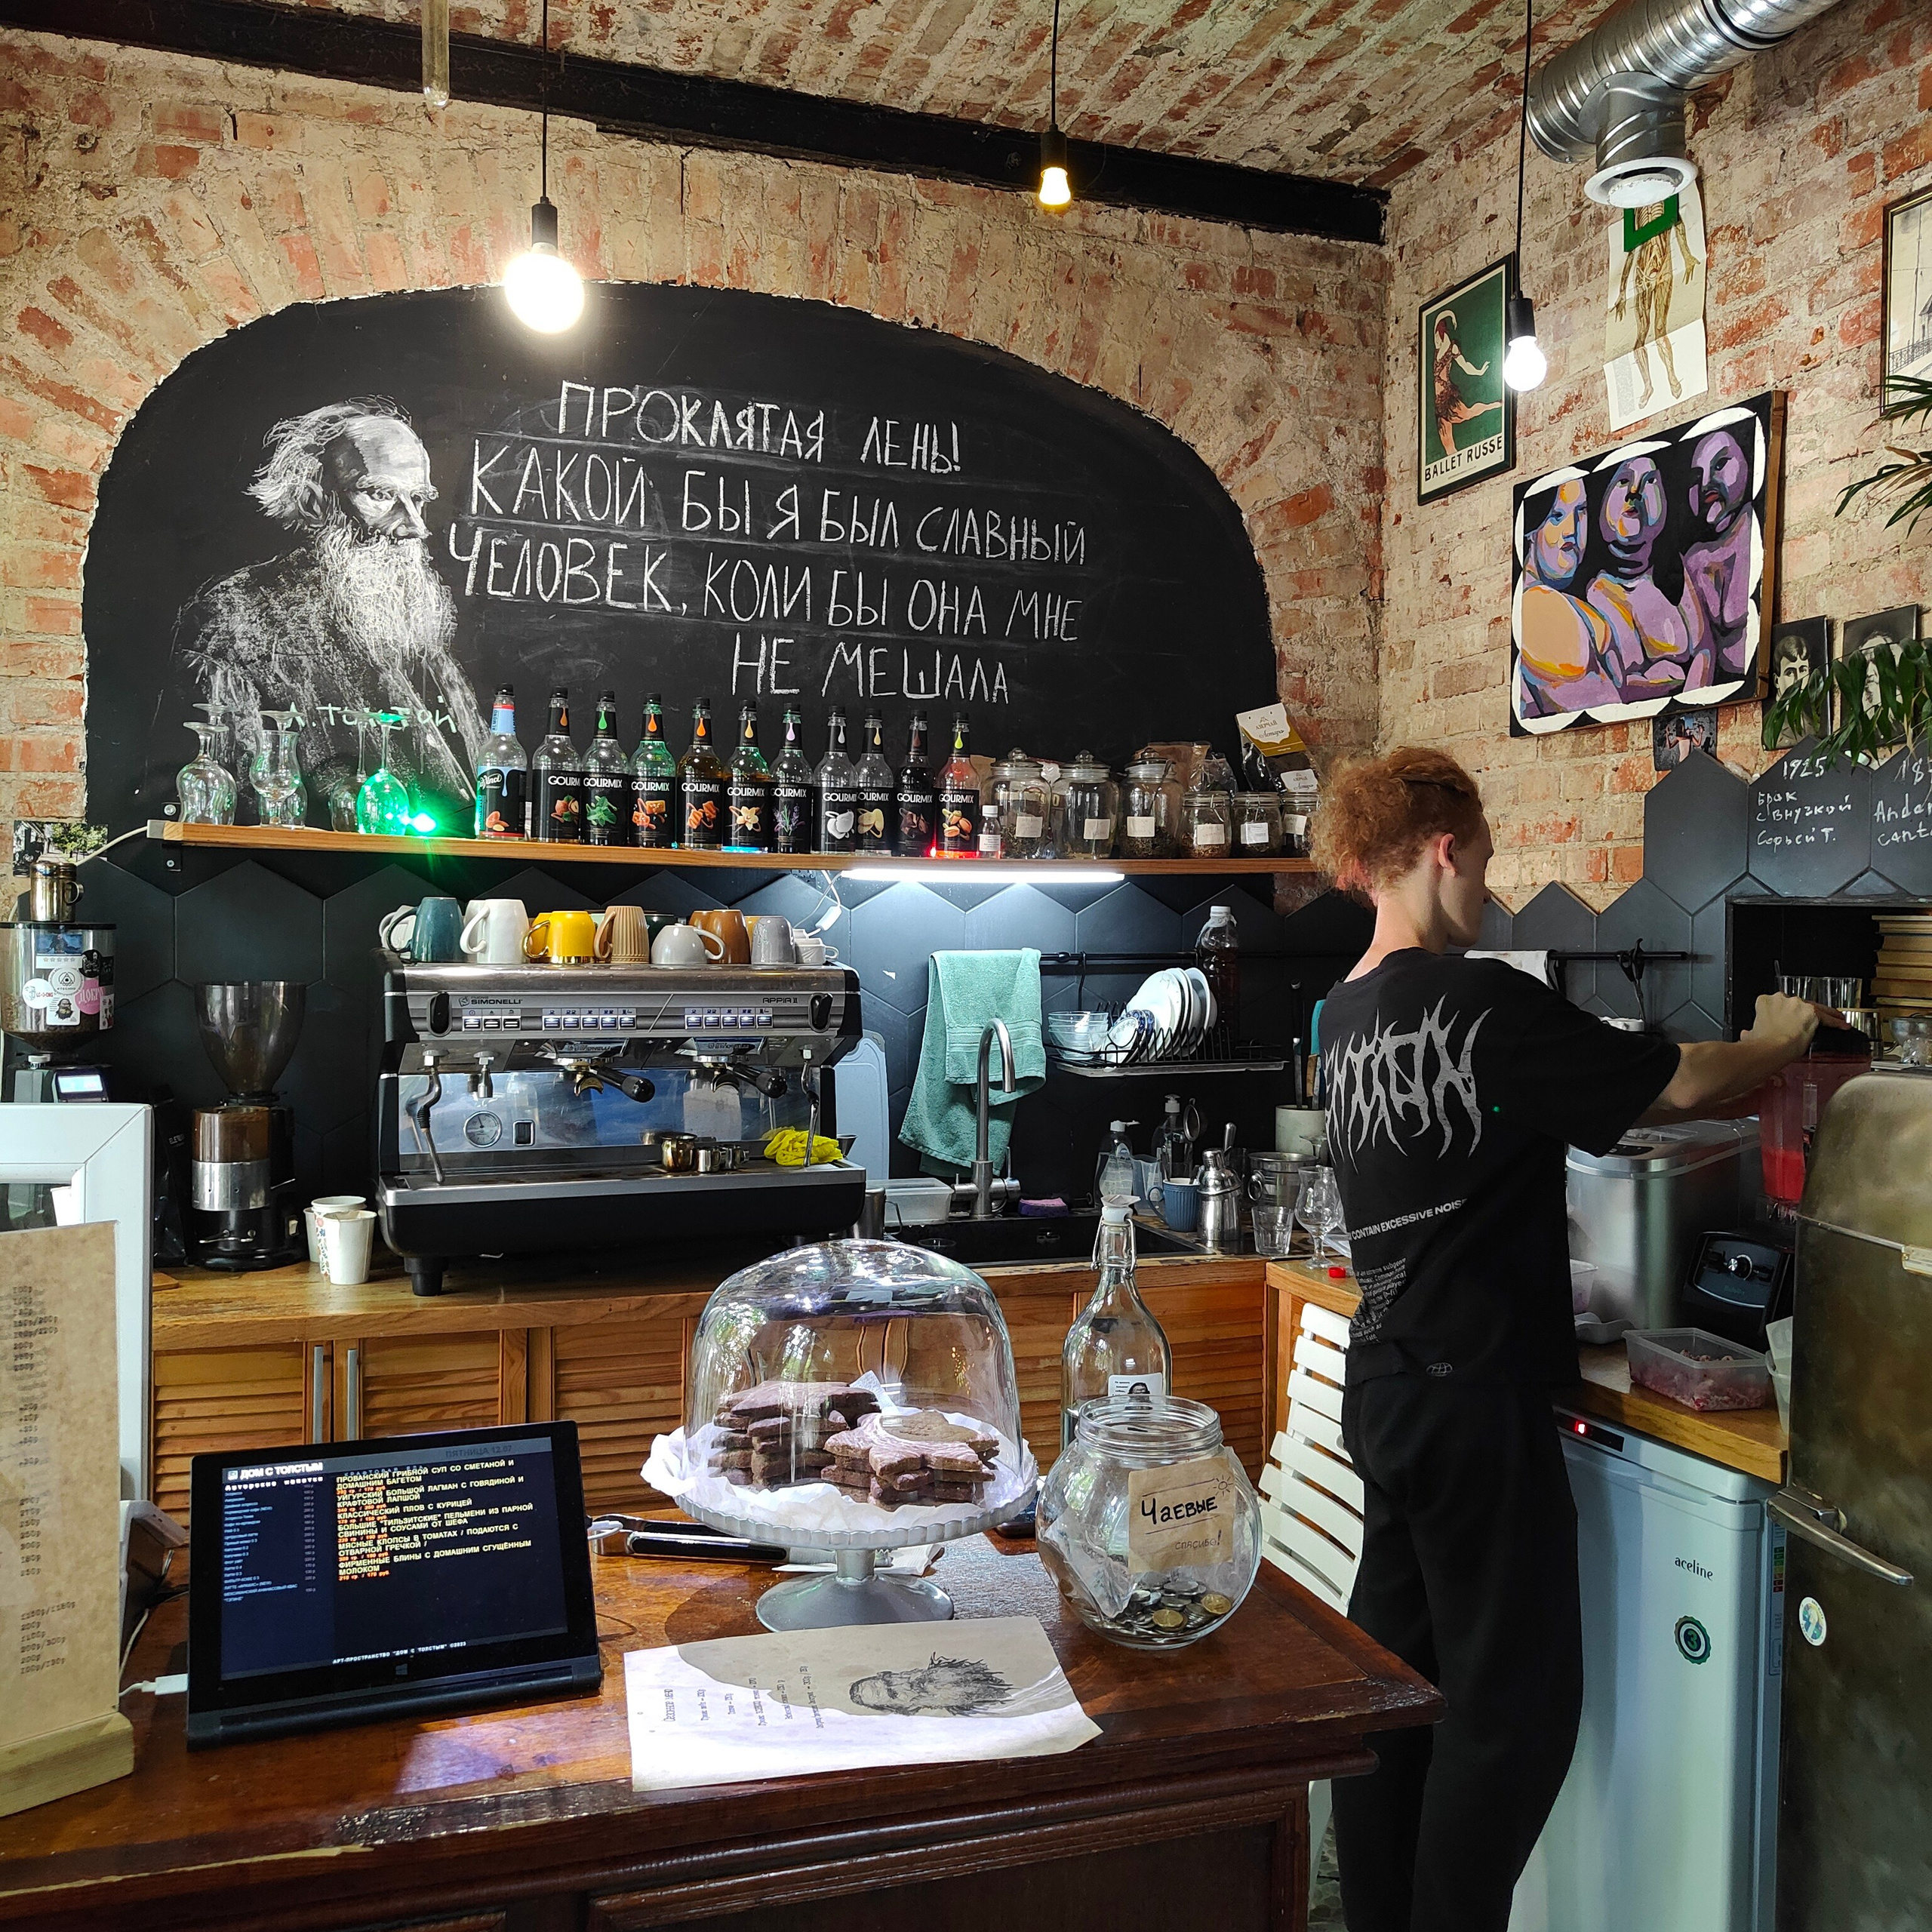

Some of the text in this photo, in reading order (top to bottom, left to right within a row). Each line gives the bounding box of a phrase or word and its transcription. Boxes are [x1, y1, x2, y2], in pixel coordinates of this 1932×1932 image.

[558, 380, 961, 475] ПРОКЛЯТАЯ ЛЕНЬ!
[1425, 453, 1463, 482] BALLET
[1466, 435, 1503, 463] RUSSE
[472, 438, 1085, 566] КАКОЙ БЫ Я БЫЛ СЛАВНЫЙ
[448, 523, 1082, 641] ЧЕЛОВЕК, КОЛИ БЫ ОНА МНЕ
[733, 632, 1008, 705] НЕ МЕШАЛА
[1782, 755, 1828, 780] 1925
[583, 777, 623, 789] GOURMIX
[631, 781, 670, 792] GOURMIX
[681, 782, 720, 792] GOURMIX
[727, 787, 765, 797] GOURMIX
[770, 788, 808, 798] GOURMIX
[897, 793, 933, 803] GOURMIX
[939, 794, 974, 804] GOURMIX
[1351, 1223, 1382, 1241] CONTAIN
[1380, 1208, 1434, 1232] EXCESSIVE
[445, 1447, 489, 1458] ПЯТНИЦА
[240, 1462, 324, 1480] ДОМ С ТОЛСТЫМ
[336, 1471, 389, 1483] ПРОВАНСКИЙ
[392, 1466, 429, 1478] ГРИБНОЙ
[432, 1465, 447, 1474] СУП
[450, 1463, 462, 1472] СО
[464, 1460, 506, 1471] СМЕТАНОЙ
[336, 1475, 422, 1491] ДОМАШНИМ БАГЕТОМ
[386, 1485, 425, 1497] БОЛЬШОЙ
[427, 1483, 458, 1493] ЛАГМАН
[469, 1476, 515, 1488] ГОВЯДИНОЙ
[337, 1494, 420, 1508] КРАФТОВОЙ ЛАПШОЙ
[337, 1506, 400, 1520] КЛАССИЧЕСКИЙ
[403, 1503, 425, 1513] ПЛОВ
[436, 1498, 472, 1509] КУРИЦЕЙ
[337, 1521, 377, 1531] БОЛЬШИЕ
[444, 1509, 487, 1520] ПЕЛЬМЕНИ
[488, 1508, 500, 1516] ИЗ
[502, 1503, 534, 1513] ПАРНОЙ
[337, 1527, 378, 1539] СВИНИНЫ
[389, 1522, 429, 1534] СОУСАМИ
[431, 1520, 442, 1528] ОТ
[445, 1518, 469, 1526] ШЕФА
[338, 1540, 374, 1550] МЯСНЫЕ
[377, 1535, 411, 1546] КЛОПСЫ
[422, 1531, 458, 1540] ТОМАТАХ
[466, 1524, 510, 1536] ПОДАЮТСЯ
[338, 1546, 383, 1557] ОТВАРНОЙ
[385, 1541, 421, 1552] ГРЕЧКОЙ
[338, 1556, 390, 1569] ФИРМЕННЫЕ
[393, 1553, 421, 1563] БЛИНЫ
[433, 1547, 480, 1558] ДОМАШНИМ
[482, 1540, 532, 1552] СГУЩЁННЫМ
[338, 1565, 380, 1576] МОЛОКОМ
[1674, 1555, 1714, 1582] aceline
[1687, 1629, 1698, 1650] 3
